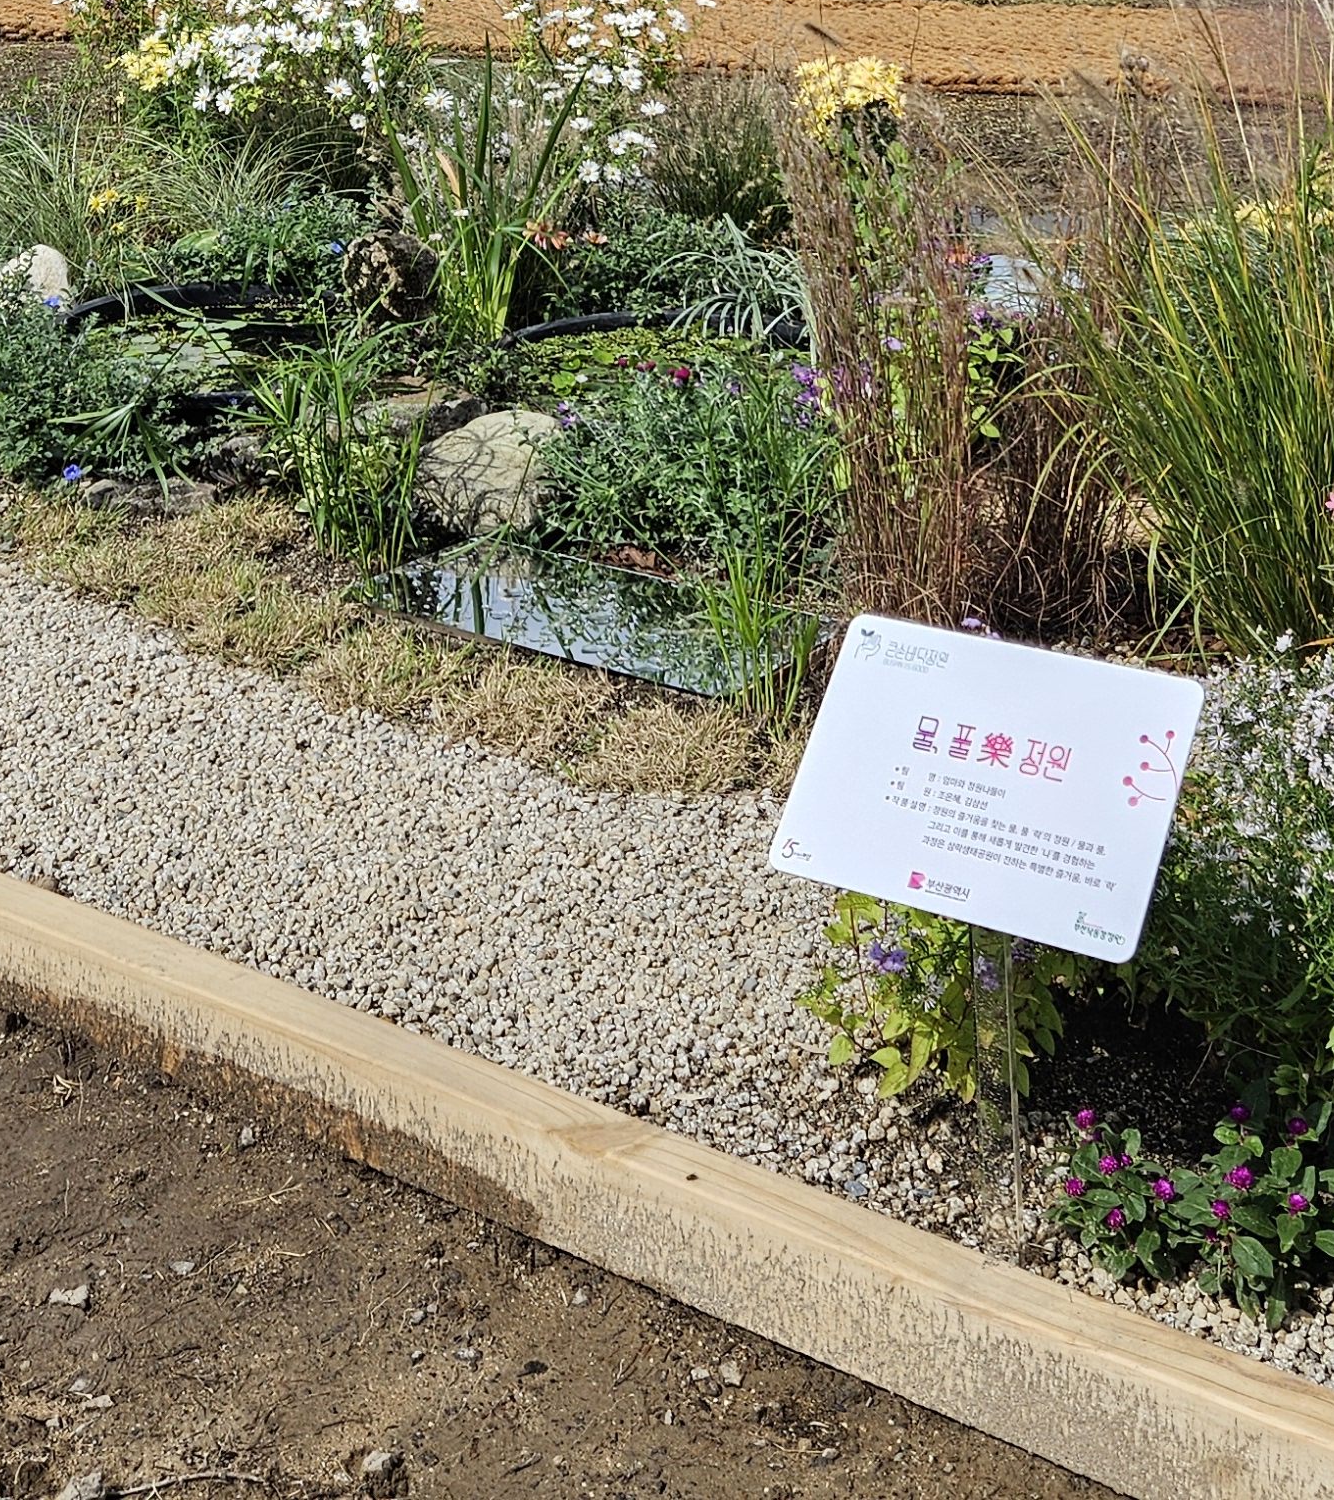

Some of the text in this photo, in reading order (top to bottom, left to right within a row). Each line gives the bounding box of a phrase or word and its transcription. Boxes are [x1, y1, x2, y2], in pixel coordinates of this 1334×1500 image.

[912, 715, 1072, 782] 물, 풀 樂 정원
[943, 776, 965, 789] 엄마와
[968, 782, 1006, 798] 정원나들이
[965, 797, 988, 810] 김삼선
[928, 821, 951, 833] 그리고
[953, 827, 968, 838] 이를
[971, 831, 987, 842] 통해
[988, 836, 1012, 849] 새롭게
[1014, 842, 1038, 855] 발견한
[1063, 854, 1095, 870] 경험하는
[933, 806, 956, 818] 정원의
[957, 812, 988, 826] 즐거움을
[991, 819, 1006, 831] 찾는
[1054, 835, 1070, 847] 정원
[922, 835, 945, 849] 과정은
[947, 842, 1001, 862] 삼락생태공원이
[1003, 856, 1027, 869] 전하는
[1029, 862, 1054, 876] 특별한
[1084, 876, 1101, 887] 바로
[926, 879, 970, 899] 부산광역시
